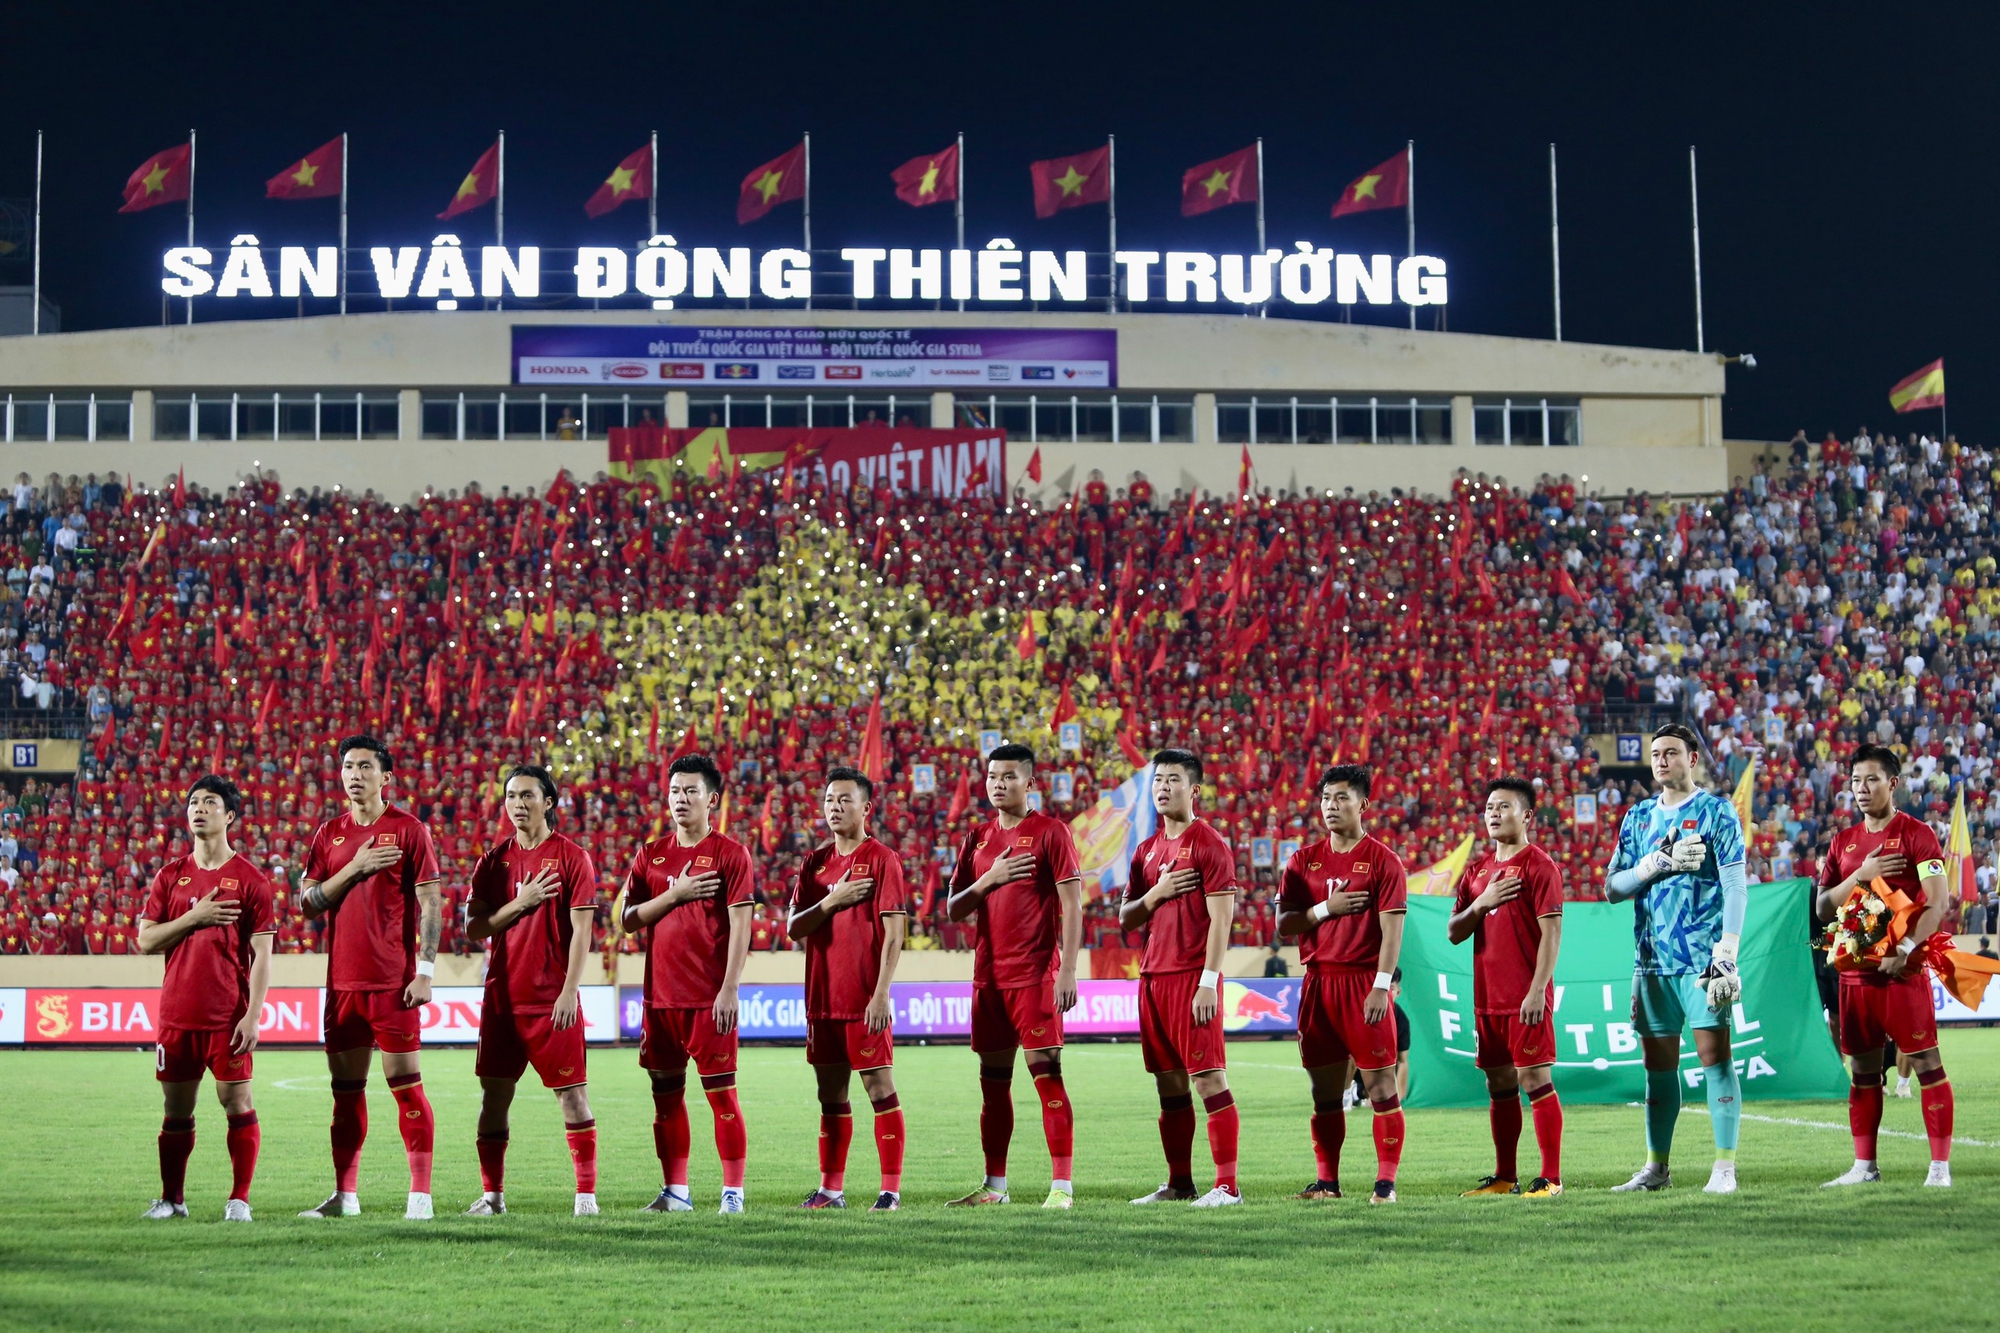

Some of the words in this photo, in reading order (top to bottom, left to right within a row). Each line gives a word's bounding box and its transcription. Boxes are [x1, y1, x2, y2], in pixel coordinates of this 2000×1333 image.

[162, 234, 338, 298] SÂN
[370, 234, 540, 310] VẬN
[573, 234, 812, 310] ĐỘNG
[841, 238, 1087, 301] THIÊN
[1115, 241, 1448, 306] TRƯỜNG
[699, 328, 733, 340] TRẬN
[735, 328, 772, 338] BÓNG
[774, 328, 792, 338] ĐÁ
[795, 330, 825, 338] GIAO
[828, 329, 856, 339] HỮU
[859, 329, 893, 339] QUỐC
[896, 329, 911, 339] TẾ
[649, 340, 669, 357] ĐỘI
[672, 339, 709, 355] TUYỂN
[711, 339, 743, 356] QUỐC
[744, 343, 765, 355] GIA
[767, 341, 793, 358] VIỆT
[795, 343, 823, 355] NAM
[831, 341, 851, 358] ĐỘI
[854, 340, 891, 356] TUYỂN
[893, 340, 925, 356] QUỐC
[926, 344, 947, 356] GIA
[949, 344, 982, 356] SYRIA
[530, 365, 590, 375] HONDA
[870, 366, 912, 378] Herbalife
[16, 747, 35, 765] B1
[1620, 739, 1640, 757] B2
[81, 1002, 153, 1031] BIA
[908, 992, 942, 1033] ĐỘI
